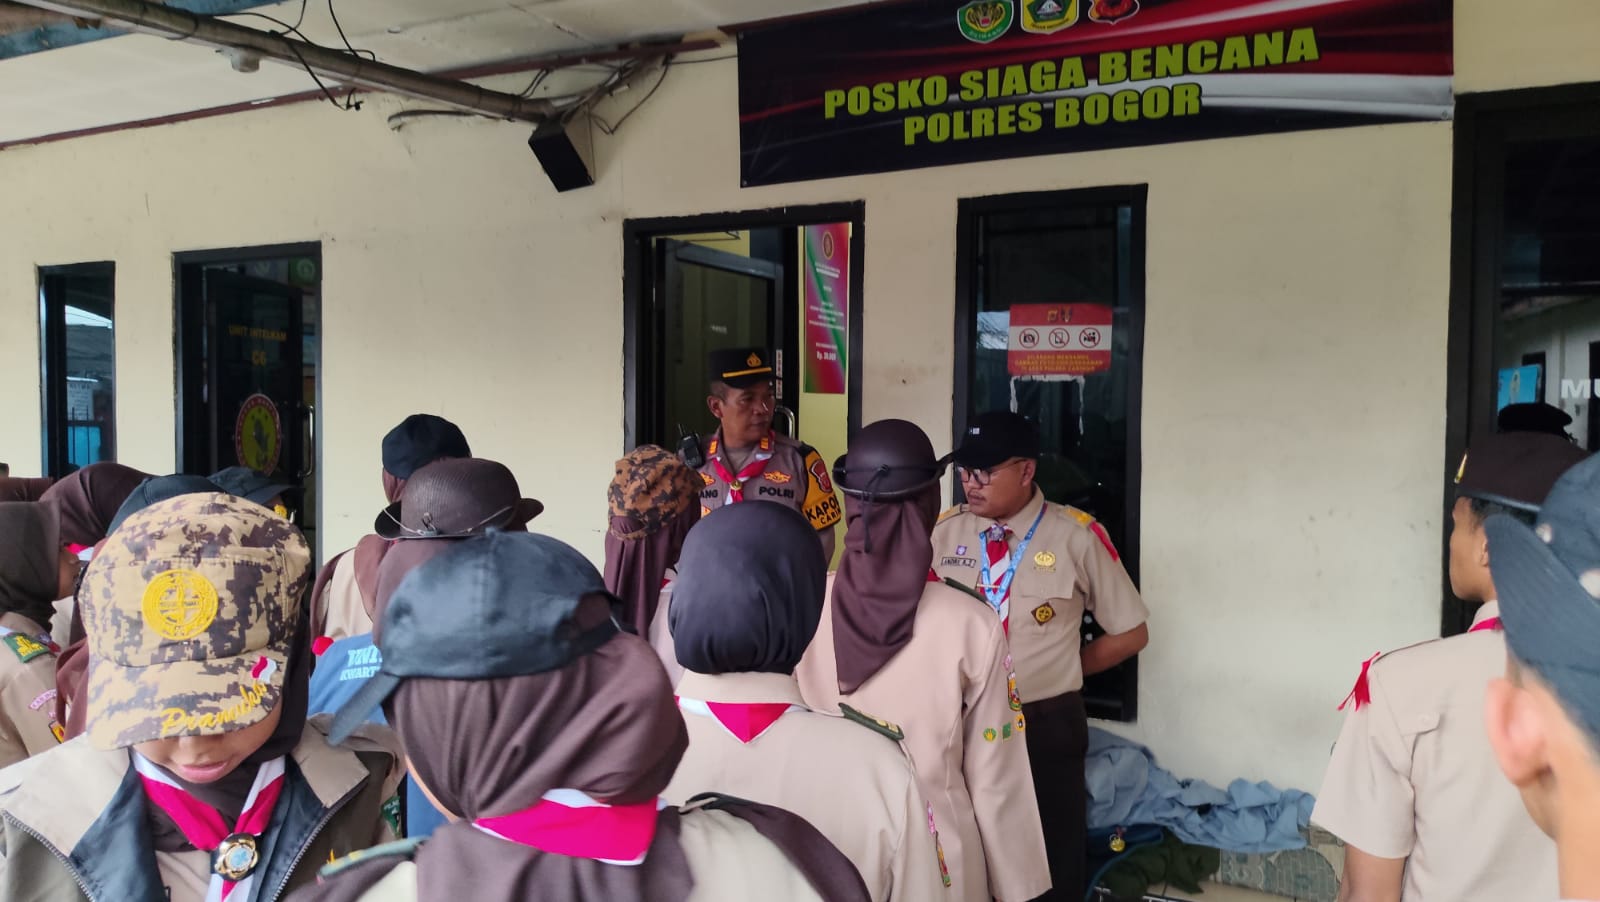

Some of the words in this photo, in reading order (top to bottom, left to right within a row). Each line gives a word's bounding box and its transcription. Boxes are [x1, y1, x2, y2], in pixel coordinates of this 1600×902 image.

[824, 75, 947, 119] POSKO
[960, 57, 1086, 101] SIAGA
[1099, 28, 1319, 84] BENCANA
[904, 101, 1037, 145] POLRES
[1055, 84, 1202, 128] BOGOR
[759, 486, 794, 499] POLRI
